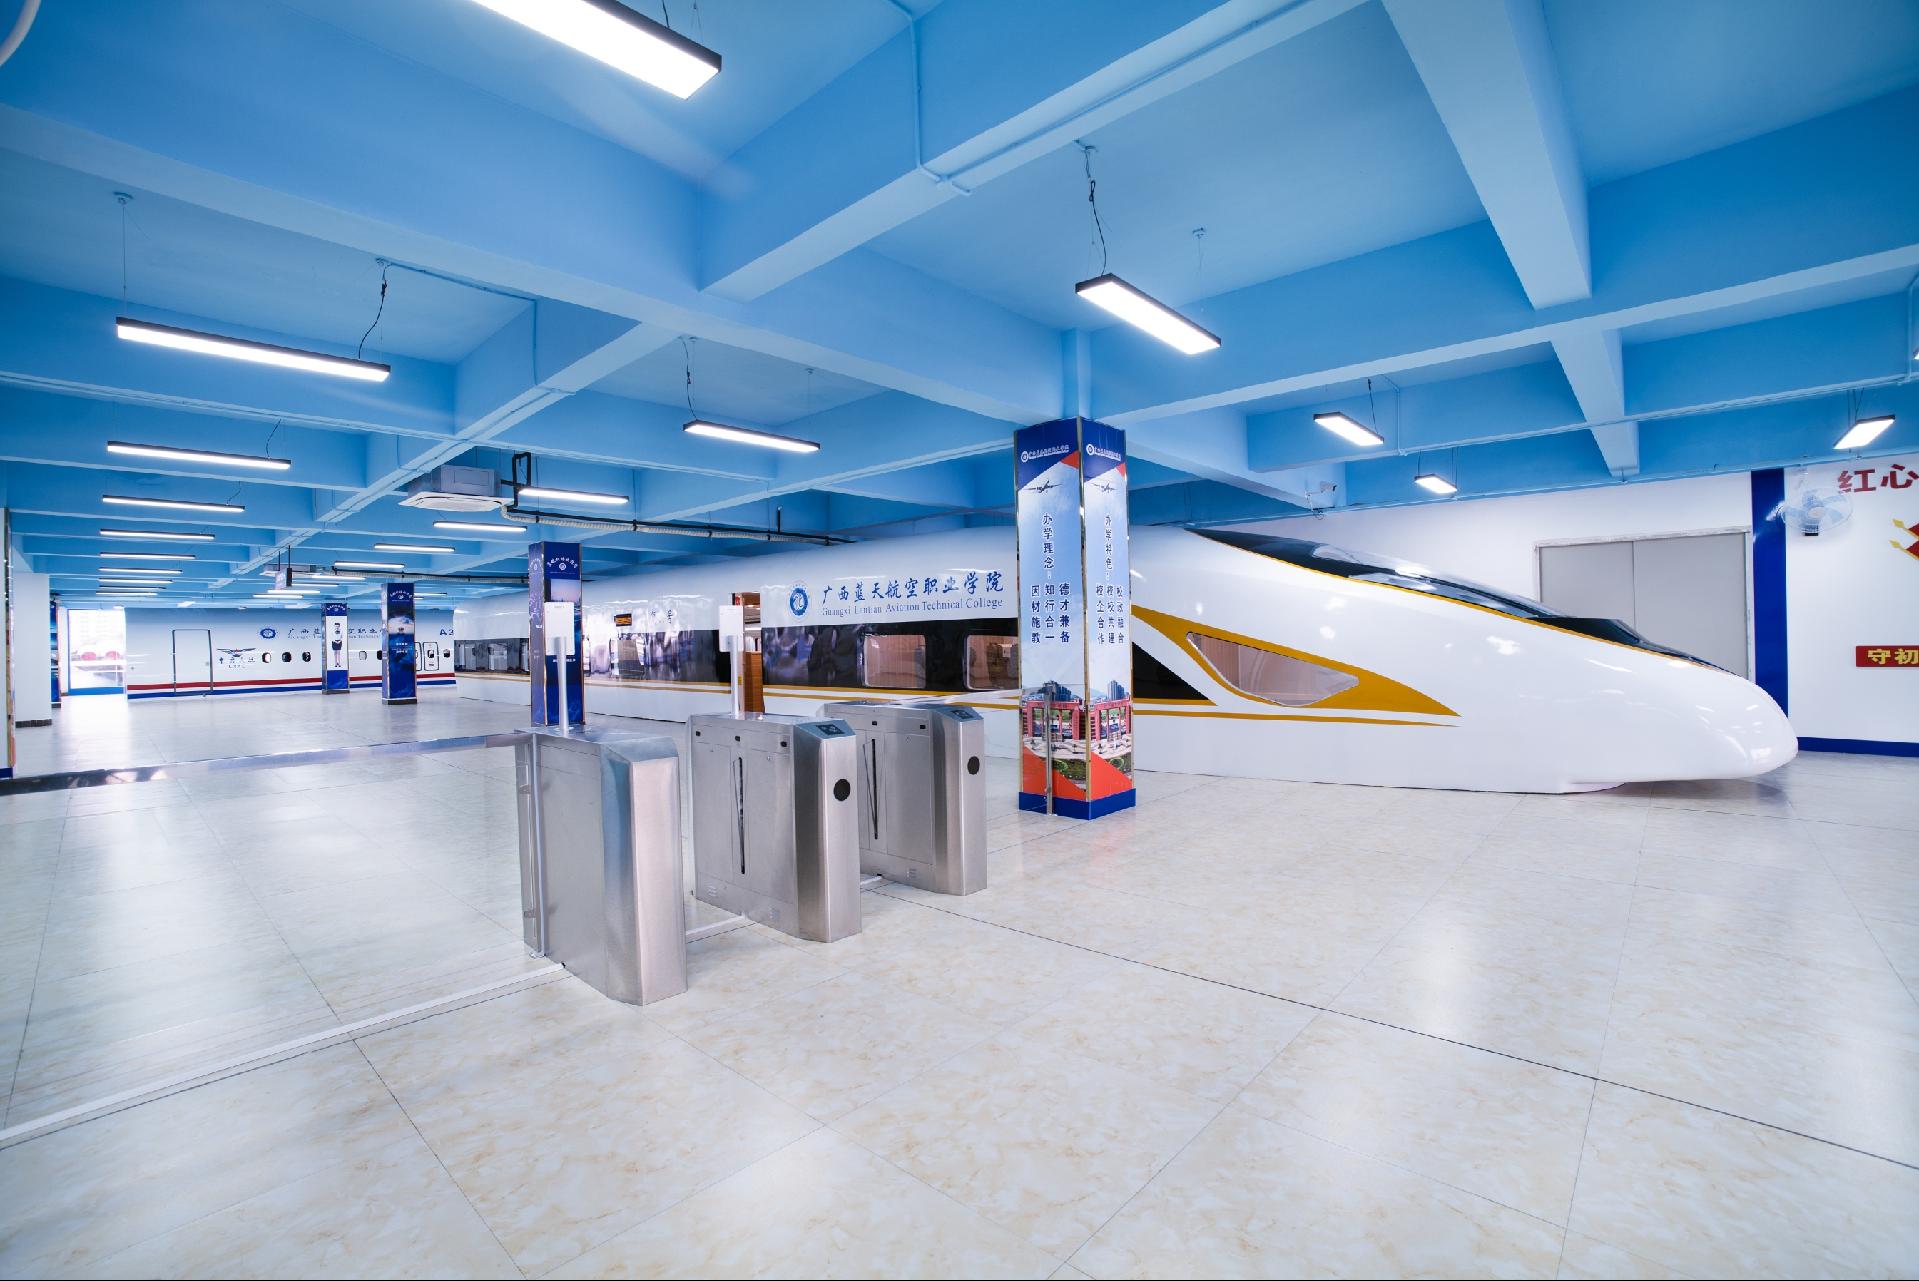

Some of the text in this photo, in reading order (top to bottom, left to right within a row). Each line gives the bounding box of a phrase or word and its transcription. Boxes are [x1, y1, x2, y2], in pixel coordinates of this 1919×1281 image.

[1838, 464, 1919, 493] 红心
[822, 571, 1004, 604] 广西蓝天航空职业学院
[885, 602, 920, 612] Aviation
[922, 596, 963, 610] Technical
[965, 597, 1003, 609] College
[1031, 585, 1041, 644] 因材施教
[1045, 584, 1055, 639] 知行合一
[1059, 583, 1070, 643] 德才兼备
[1867, 648, 1919, 665] 守初
